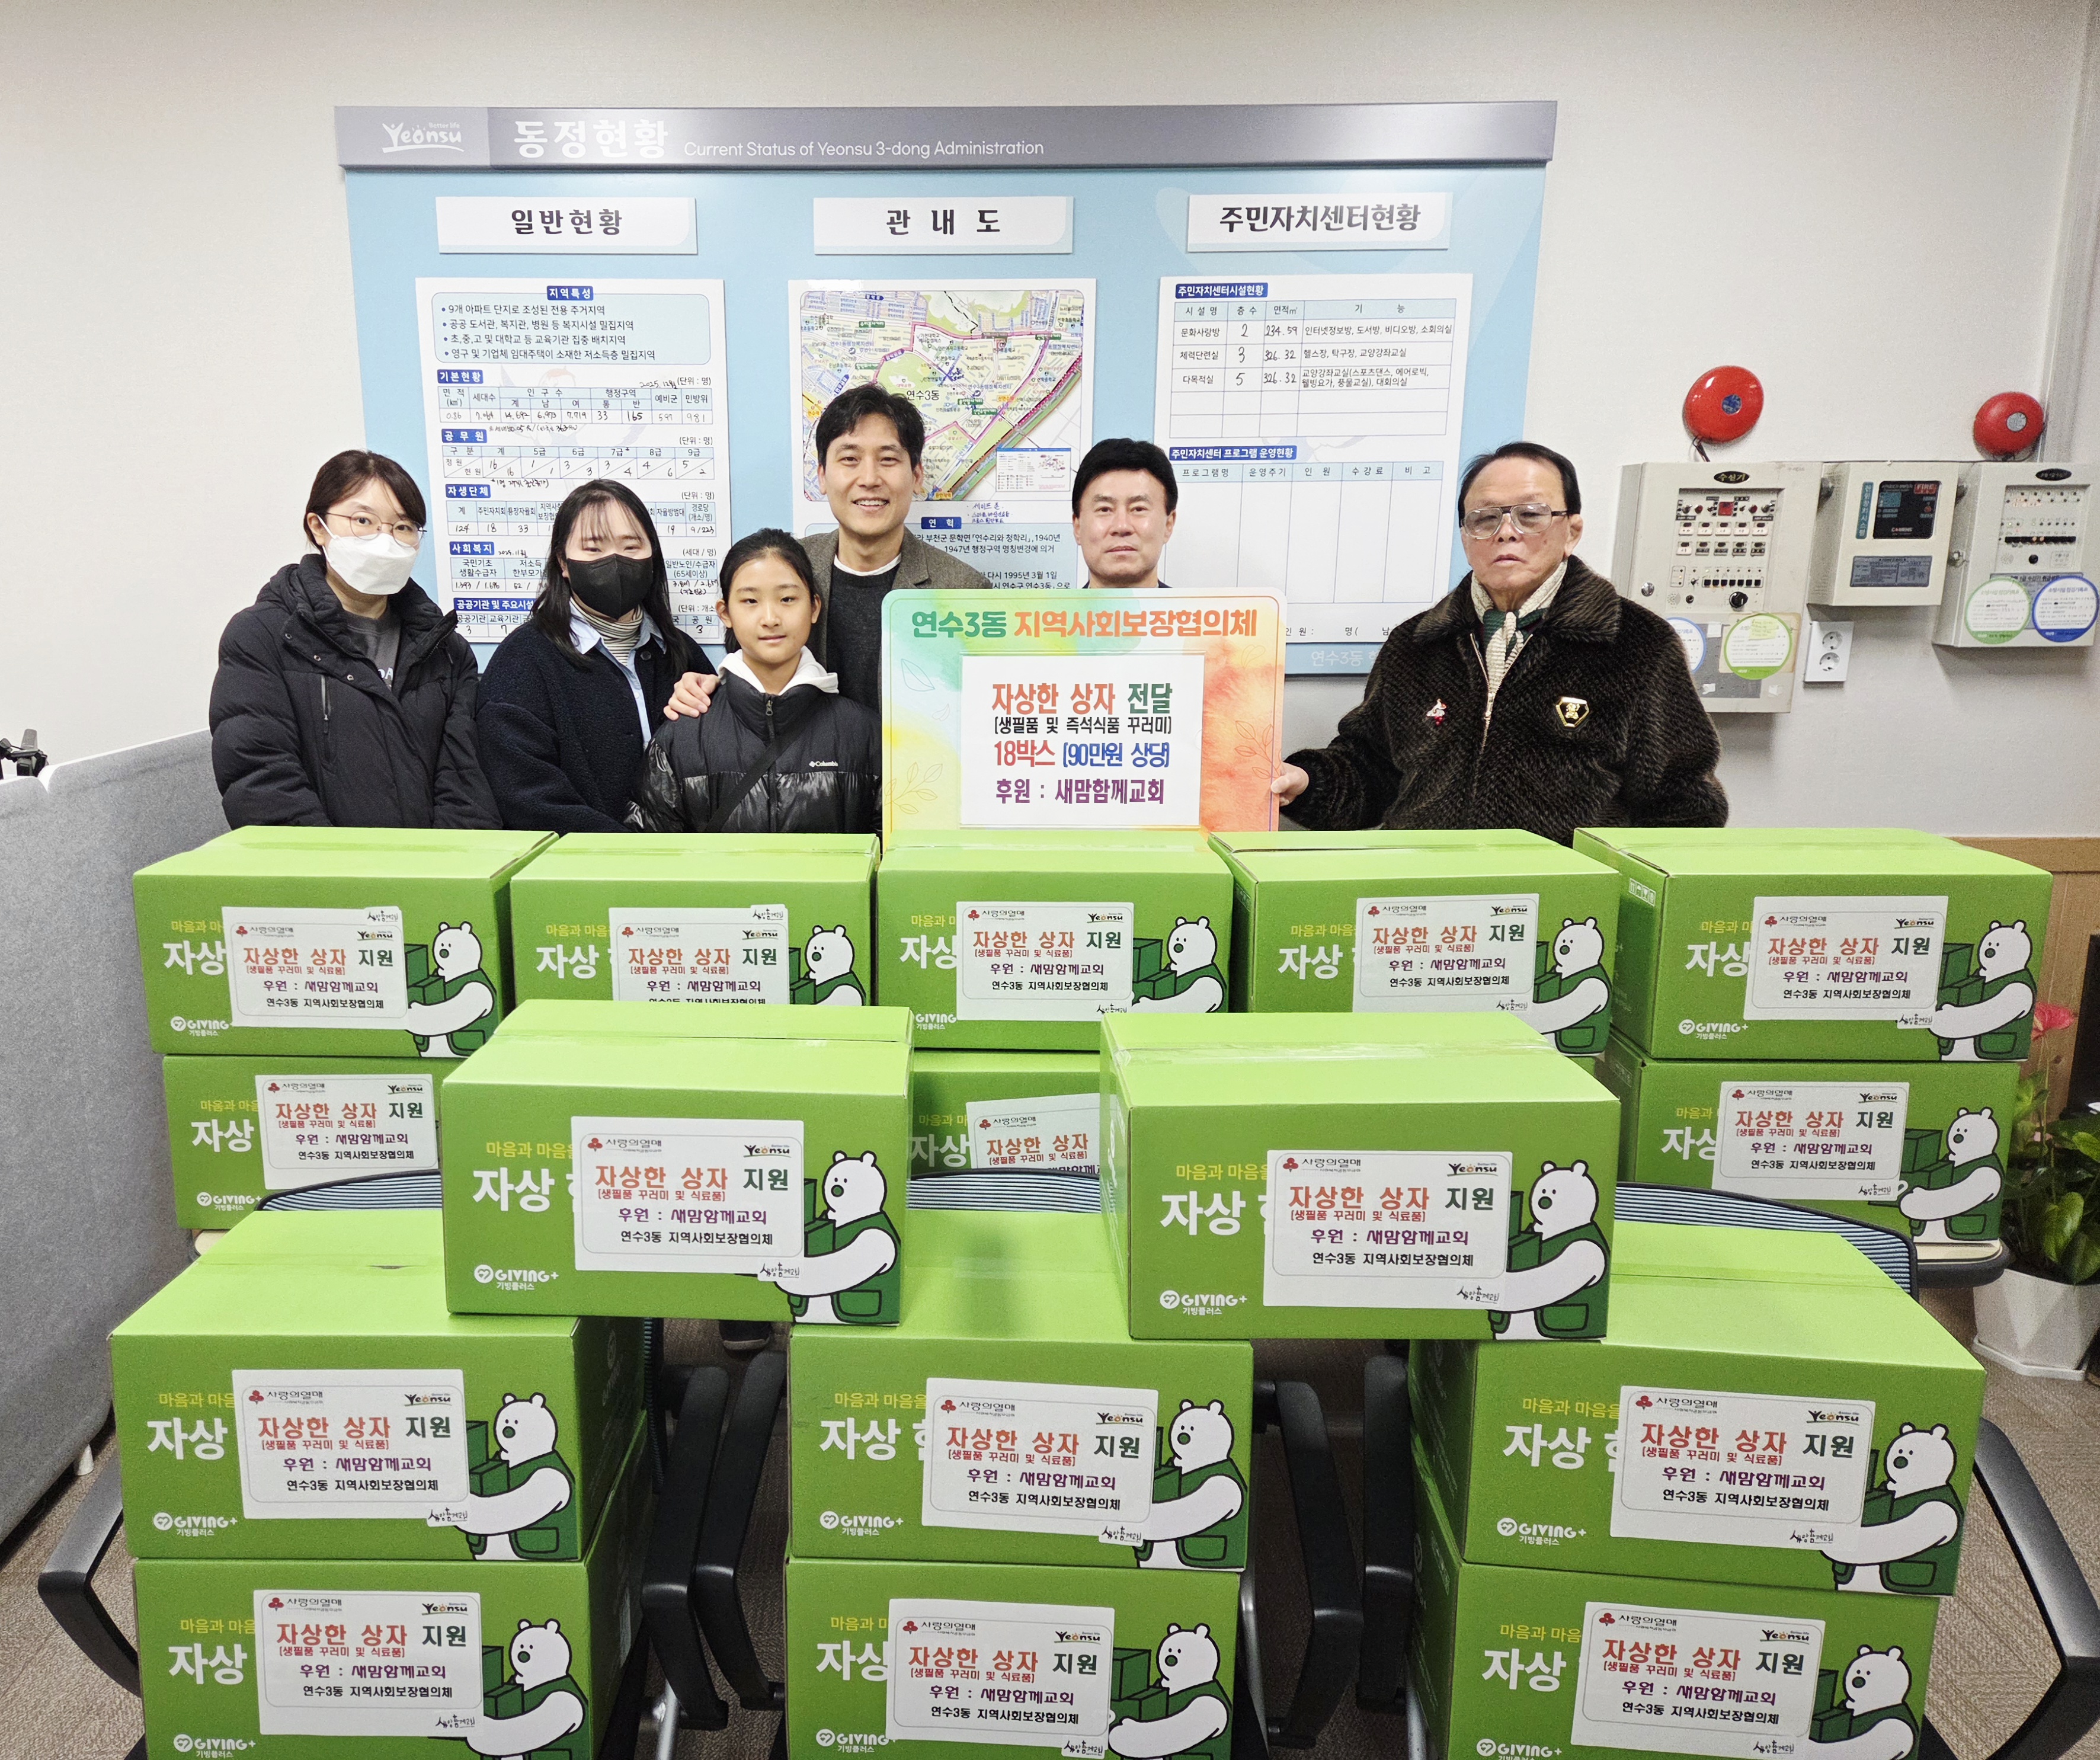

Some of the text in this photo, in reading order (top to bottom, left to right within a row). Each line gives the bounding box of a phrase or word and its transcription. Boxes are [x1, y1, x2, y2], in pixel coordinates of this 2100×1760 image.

[382, 122, 461, 147] Yeonsu
[513, 118, 668, 159] 동정현황
[683, 140, 1043, 159] Current Status of Yeonsu 3-dong Administration
[512, 209, 622, 235] 일반현황
[1220, 204, 1421, 232] 주민자치센터현황
[549, 288, 590, 299] 지역특성
[1178, 285, 1264, 296] 주민자치센터시설현황
[449, 305, 604, 315] 9개 아파트 단지로 조성된 전용 주거지역
[450, 319, 633, 330] 공공 도서관, 복지관, 병원 등 복지시설 밀집지역
[1181, 328, 1219, 337] 문화사랑방
[1305, 327, 1353, 335] 인터넷정보방,
[1421, 325, 1452, 334] 소회의실
[485, 334, 492, 344] 및
[495, 335, 521, 344] 대학교
[524, 335, 532, 344] 등
[535, 335, 569, 344] 교육기관
[572, 335, 588, 345] 집중
[592, 335, 625, 345] 배치지역
[452, 349, 655, 360] 영구 및 기업체 임대주택이 소재한 저소득층 밀집지역
[1180, 351, 1218, 360] 체력단련실
[1360, 348, 1406, 357] 교양강좌교실
[440, 372, 481, 382] 기본현황
[1183, 375, 1213, 384] 다목적실
[1376, 377, 1407, 386] 대회의실
[606, 389, 636, 398] 행정구역
[655, 395, 677, 403] 예비군
[686, 395, 708, 404] 민방위
[905, 391, 939, 402] 연수3동
[628, 411, 642, 421] 165
[1171, 448, 1294, 459] 주민자치센터 프로그램 운영현황
[448, 487, 488, 496] 자생단체
[452, 544, 491, 553] 사회복지
[945, 545, 969, 553] 1947년
[972, 545, 1000, 553] 행정구역
[1003, 545, 1038, 553] 명칭변경에
[457, 600, 489, 609] 공공기관
[912, 609, 1257, 638] 연수3동 지역사회보장협의체
[992, 683, 1172, 715] 자상한 상자 전달
[1046, 717, 1058, 734] 및
[1067, 717, 1119, 734] 즉석식품
[994, 740, 1055, 767] 18박스
[996, 779, 1164, 804] 후원 새맘함께교회
[1768, 937, 1930, 955] 자상한 상자 지원
[244, 948, 393, 967] 자상한 상자 지원
[1278, 944, 1343, 980] 자상
[687, 981, 760, 992] 새맘함께교회
[993, 981, 1108, 991] 연수3동 지역사회보장협의체
[336, 1134, 408, 1144] 새맘함께교회
[606, 1139, 661, 1148] 사랑의열매
[486, 1141, 532, 1158] 마음과
[744, 1144, 791, 1156] Yeonsu
[1020, 1154, 1043, 1163] 꾸러미
[1790, 1161, 1875, 1170] 지역사회보장협의체
[596, 1166, 787, 1191] 자상한 상자 지원
[473, 1167, 555, 1212] 자상
[639, 1190, 668, 1200] 꾸러미
[676, 1191, 684, 1201] 및
[619, 1208, 766, 1225] 후원 새맘함께교회
[621, 1231, 772, 1244] 연수3동 지역사회보장협의체
[1366, 1230, 1468, 1245] 새맘함께교회
[497, 1281, 536, 1291] 기빙플러스
[1094, 1436, 1139, 1458] 지원
[1503, 1424, 1591, 1469] 자상
[335, 1480, 438, 1491] 지역사회보장협의체
[1676, 1685, 1775, 1706] 새맘함께교회
